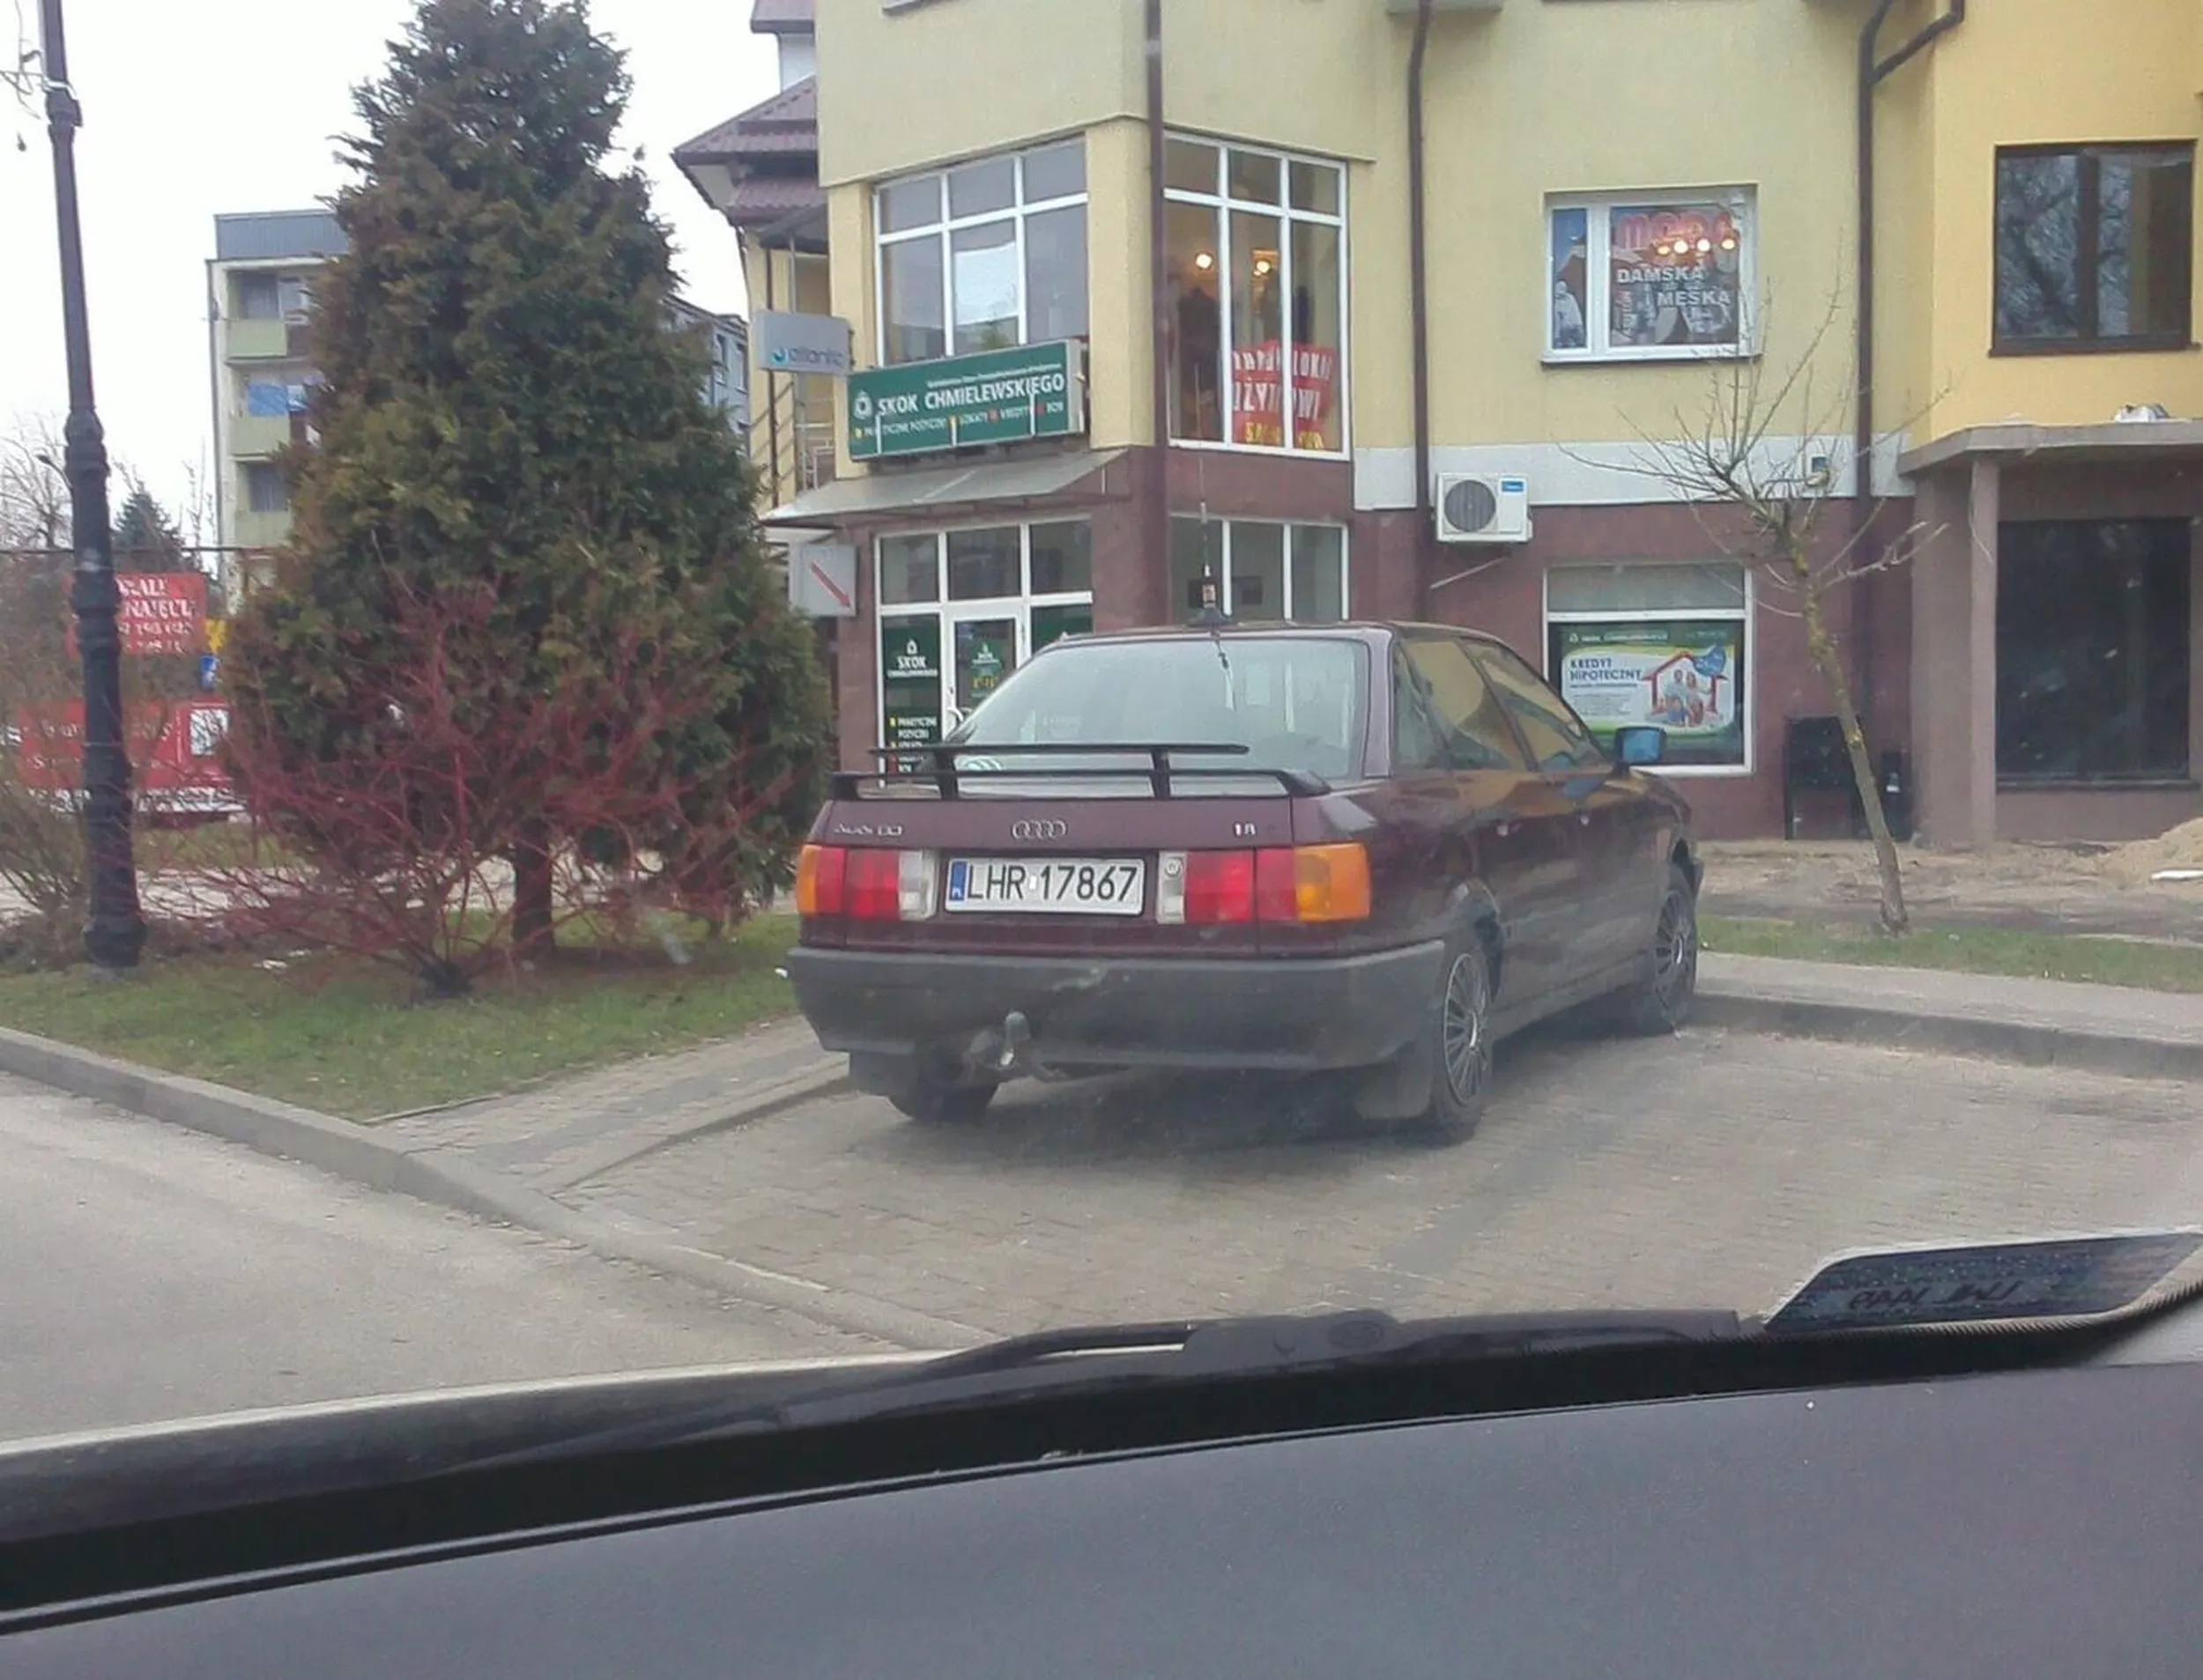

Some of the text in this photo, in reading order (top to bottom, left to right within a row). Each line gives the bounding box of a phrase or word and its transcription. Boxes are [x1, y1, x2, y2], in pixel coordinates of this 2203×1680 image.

[879, 393, 919, 417] SKOK
[925, 373, 1065, 411] CHMIELEWSKIEGO
[1569, 658, 1612, 669] KREDYT
[1569, 669, 1642, 682] HIPOTECZNY
[968, 864, 1139, 902] LHR 17867
